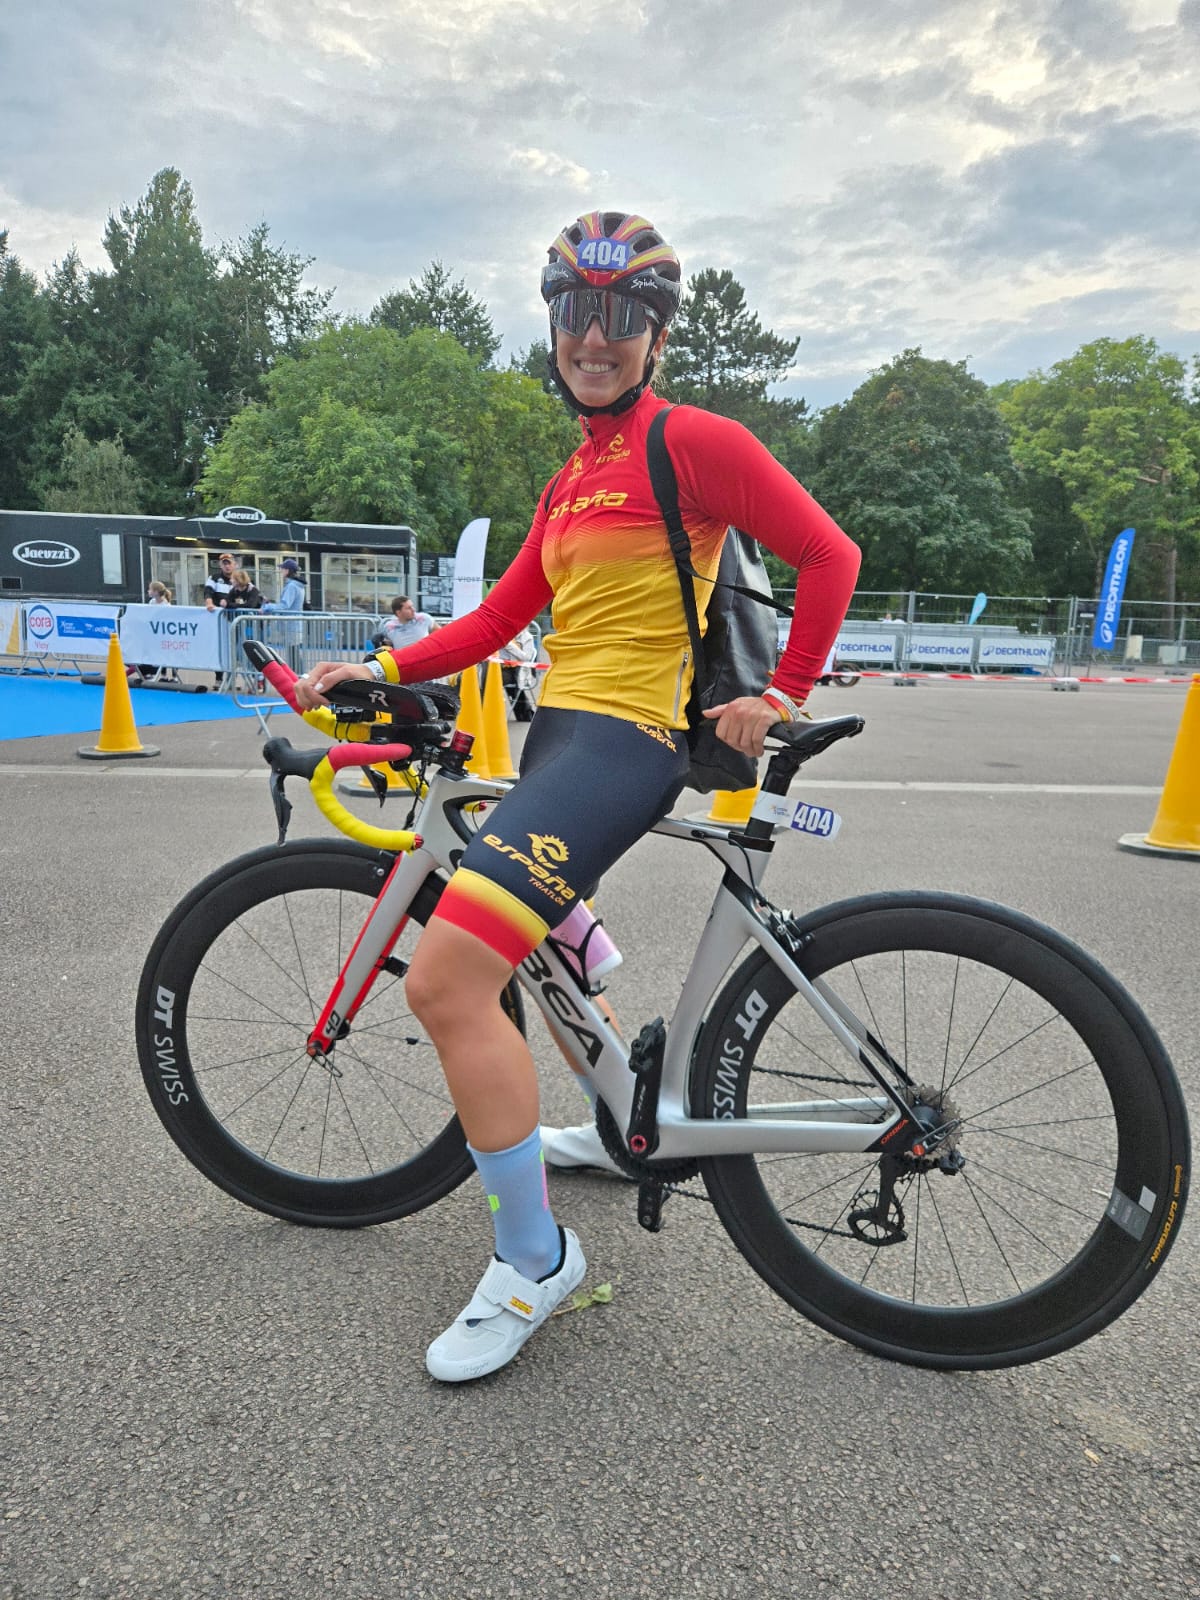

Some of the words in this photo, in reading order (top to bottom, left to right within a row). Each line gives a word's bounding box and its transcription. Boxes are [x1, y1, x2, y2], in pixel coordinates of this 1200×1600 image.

[581, 241, 627, 267] 404
[225, 511, 259, 520] Jacuzzi
[21, 547, 70, 560] Jacuzzi
[1103, 539, 1129, 622] DECATHLON
[29, 616, 52, 628] cora
[150, 621, 198, 636] VICHY
[161, 640, 191, 651] SPORT
[841, 643, 893, 653] DECATHLON
[918, 645, 970, 655] DECATHLON
[995, 646, 1047, 657] DECATHLON
[794, 805, 832, 835] 404
[153, 985, 176, 1030] DT
[521, 948, 605, 1068] BEA
[735, 989, 769, 1041] DT
[154, 1034, 189, 1106] SWISS
